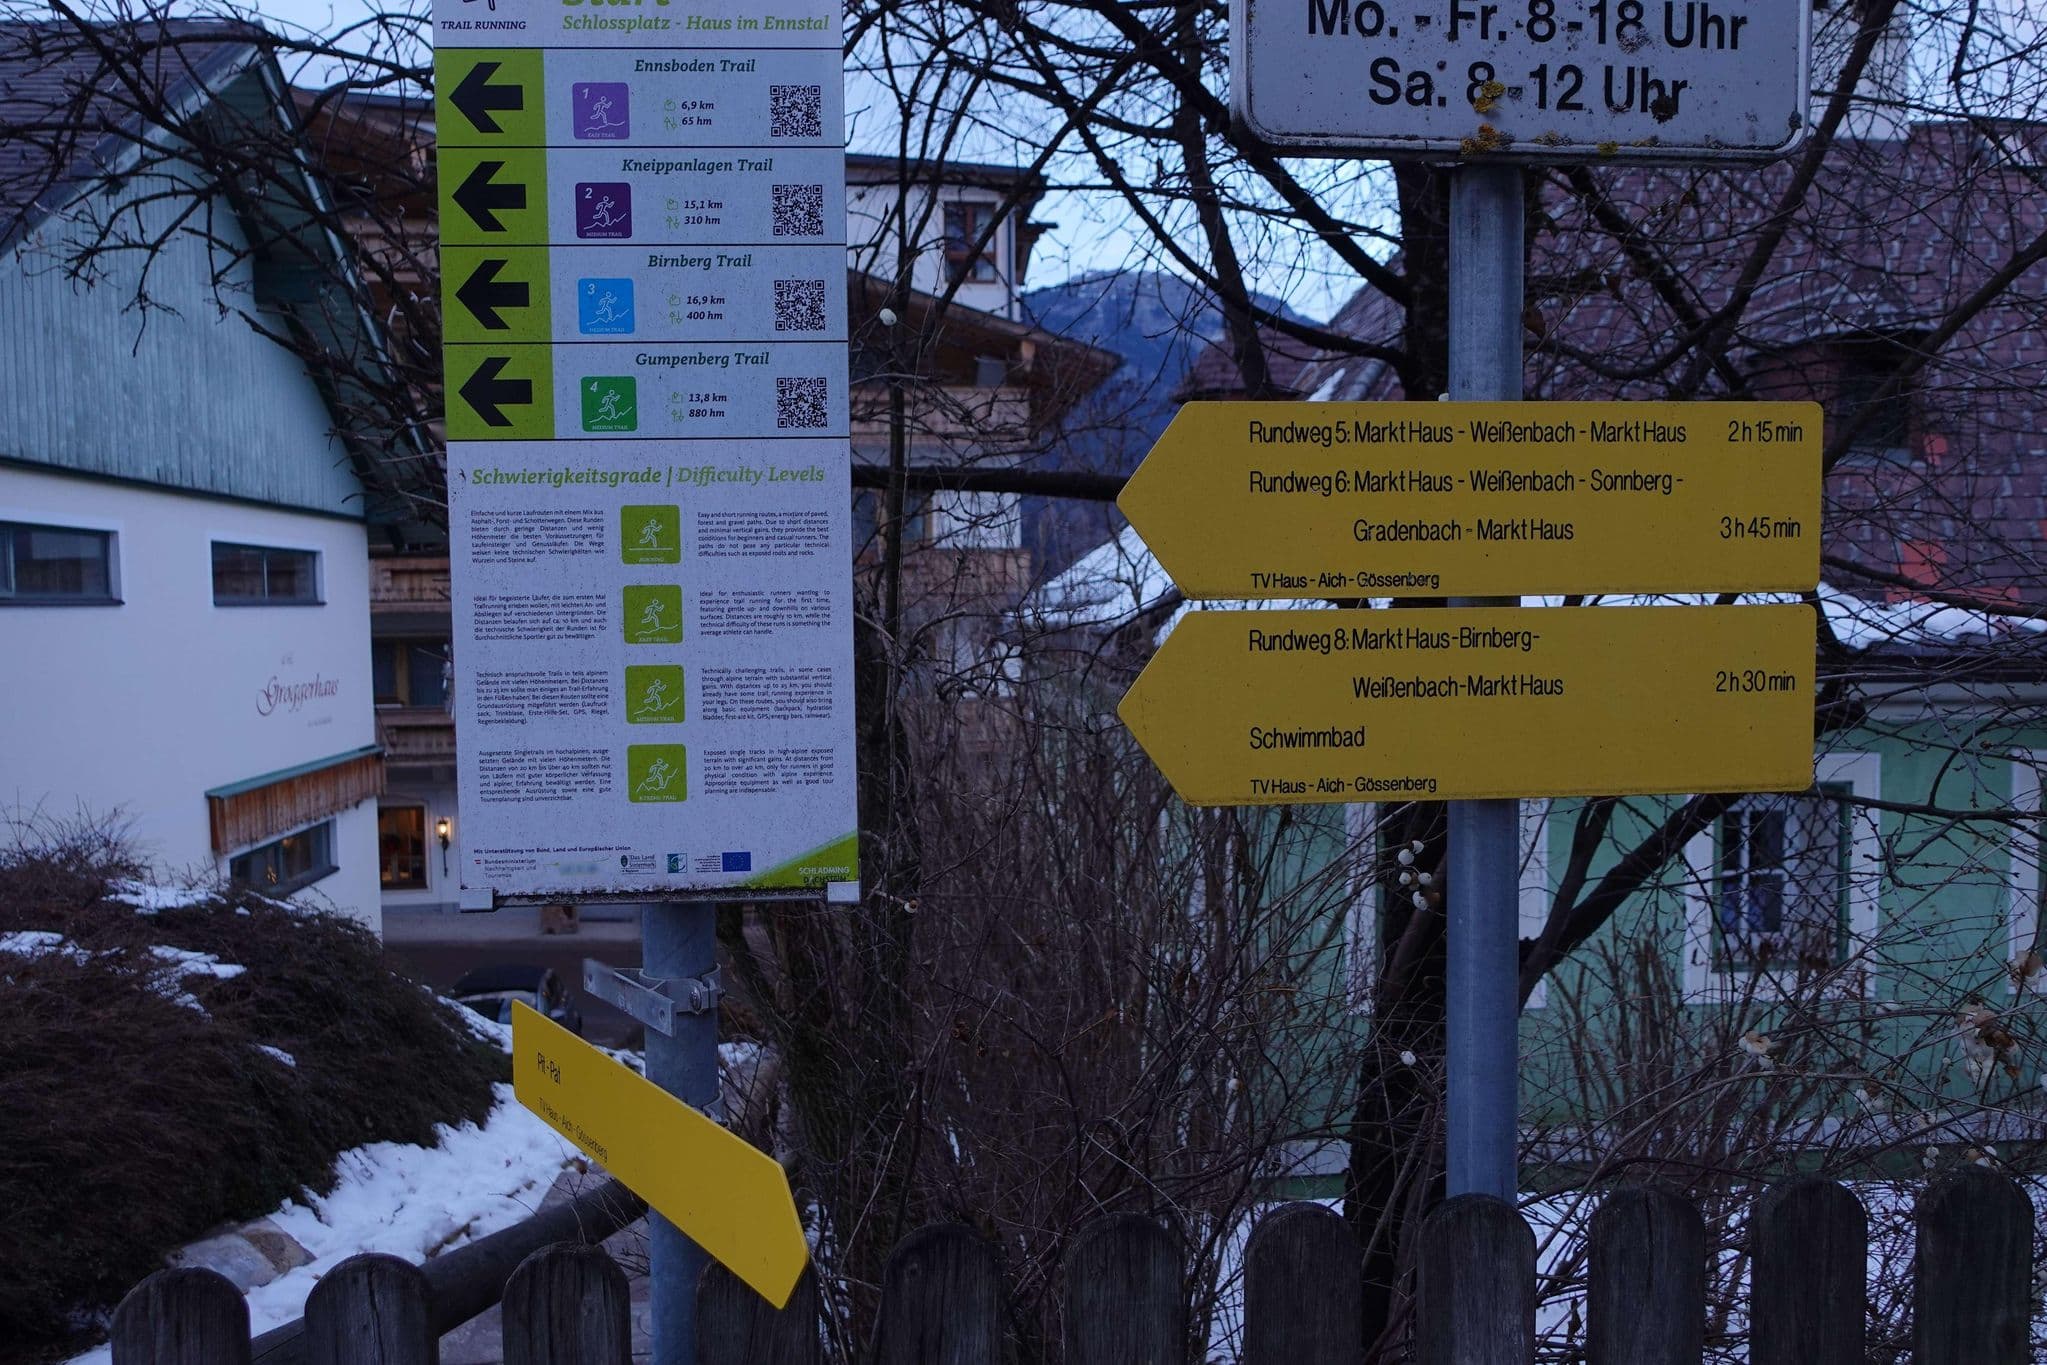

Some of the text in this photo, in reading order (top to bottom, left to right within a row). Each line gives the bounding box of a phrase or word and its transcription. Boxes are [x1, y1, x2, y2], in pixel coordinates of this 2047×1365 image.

[441, 21, 527, 30] TRAIL RUNNING
[563, 14, 671, 35] Schlossplatz
[686, 15, 732, 31] Haus
[737, 15, 758, 30] im
[763, 15, 829, 31] Ennstal
[1308, 0, 1399, 37] Mo.
[1449, 0, 1507, 41] Fr.
[1664, 1, 1747, 50] Uhr
[634, 59, 756, 73] Ennsboden Trail
[583, 88, 589, 99] 1
[1368, 56, 1447, 107] Sa.
[1604, 65, 1688, 114] Uhr
[681, 100, 714, 111] 6,9 km
[682, 116, 712, 126] 65 hm
[622, 158, 773, 175] Kneippanlagen Trail
[585, 187, 593, 199] 2
[684, 200, 723, 211] 15,1 km
[684, 215, 721, 225] 310 hm
[647, 254, 752, 271] Birnberg Trail
[587, 283, 596, 295] 3
[686, 295, 725, 306] 16,9 km
[686, 310, 723, 320] 400 hm
[635, 351, 770, 370] Gumpenberg Trail
[590, 381, 598, 393] 4
[689, 393, 727, 404] 13,8 km
[689, 408, 725, 418] 880 hm
[1250, 421, 1332, 448] Rundweg
[1335, 421, 1351, 444] 5:
[1355, 421, 1406, 443] Markt
[1409, 421, 1453, 443] Haus
[1470, 421, 1575, 443] Weißenbach
[1591, 421, 1641, 443] Markt
[1643, 421, 1687, 443] Haus
[472, 466, 662, 489] Schwierigkeitsgrade
[678, 466, 764, 487] Difficulty
[768, 465, 825, 482] Levels
[1250, 470, 1332, 498] Rundweg
[1335, 470, 1350, 493] 6:
[1354, 470, 1406, 493] Markt
[1409, 470, 1453, 492] Haus
[1470, 470, 1574, 492] Weißenbach
[1590, 469, 1672, 496] Sonnberg
[1354, 519, 1462, 542] Gradenbach
[1477, 518, 1528, 541] Markt
[1531, 518, 1574, 540] Haus
[1250, 573, 1271, 589] TV
[1272, 572, 1308, 589] Haus
[1318, 572, 1347, 588] Aich
[1356, 571, 1440, 591] Gössenberg
[1249, 629, 1331, 656] Rundweg
[1334, 628, 1349, 651] 8:
[1352, 628, 1403, 650] Markt
[1520, 674, 1564, 696] Haus
[256, 672, 339, 717] Groggerhaus
[1250, 726, 1365, 750] Schwimmbad
[1250, 779, 1270, 795] TV
[1271, 778, 1306, 794] Haus
[1316, 777, 1345, 794] Aich
[1354, 775, 1437, 795] Gössenberg
[799, 866, 850, 876] SCHLADMING
